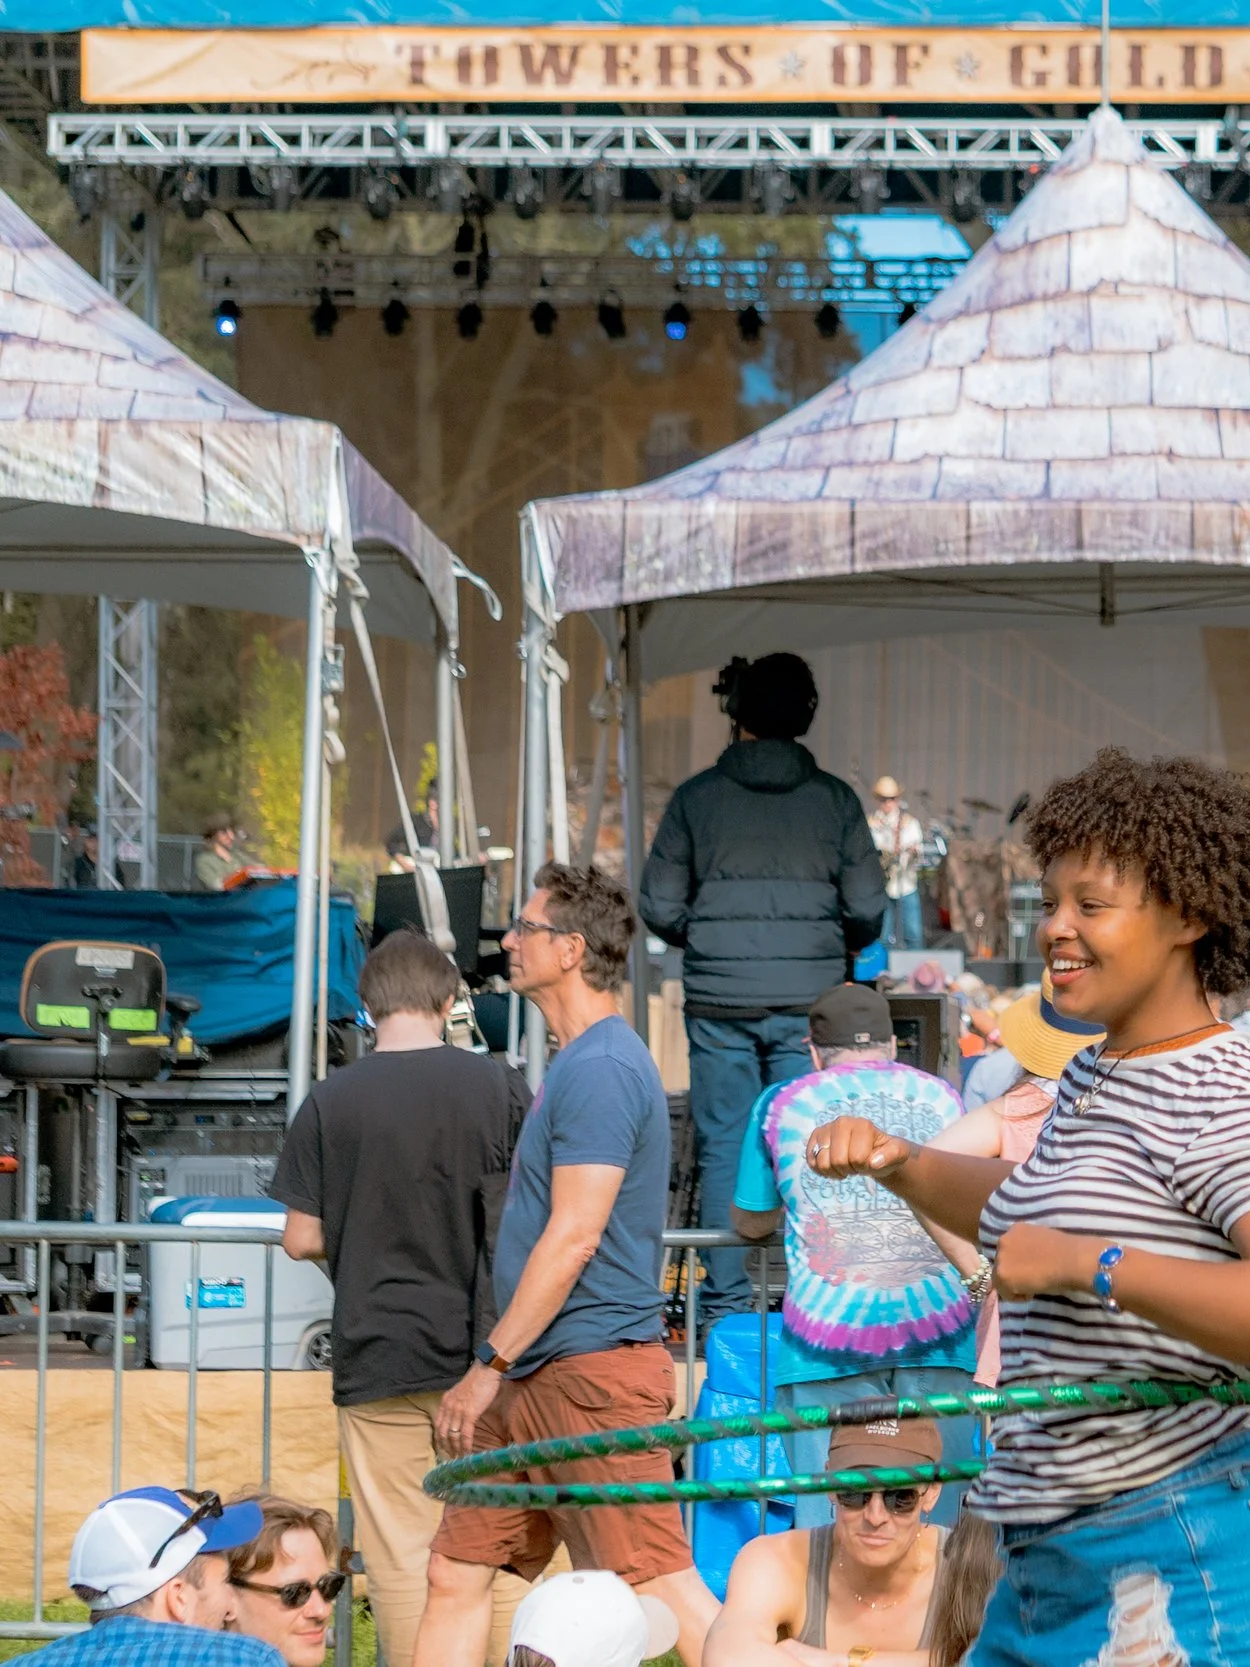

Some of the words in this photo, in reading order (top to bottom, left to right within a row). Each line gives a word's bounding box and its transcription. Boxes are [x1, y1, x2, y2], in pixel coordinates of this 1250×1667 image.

[396, 43, 754, 87] TOWERS
[831, 43, 930, 88] OF
[1009, 43, 1225, 89] GOLD
